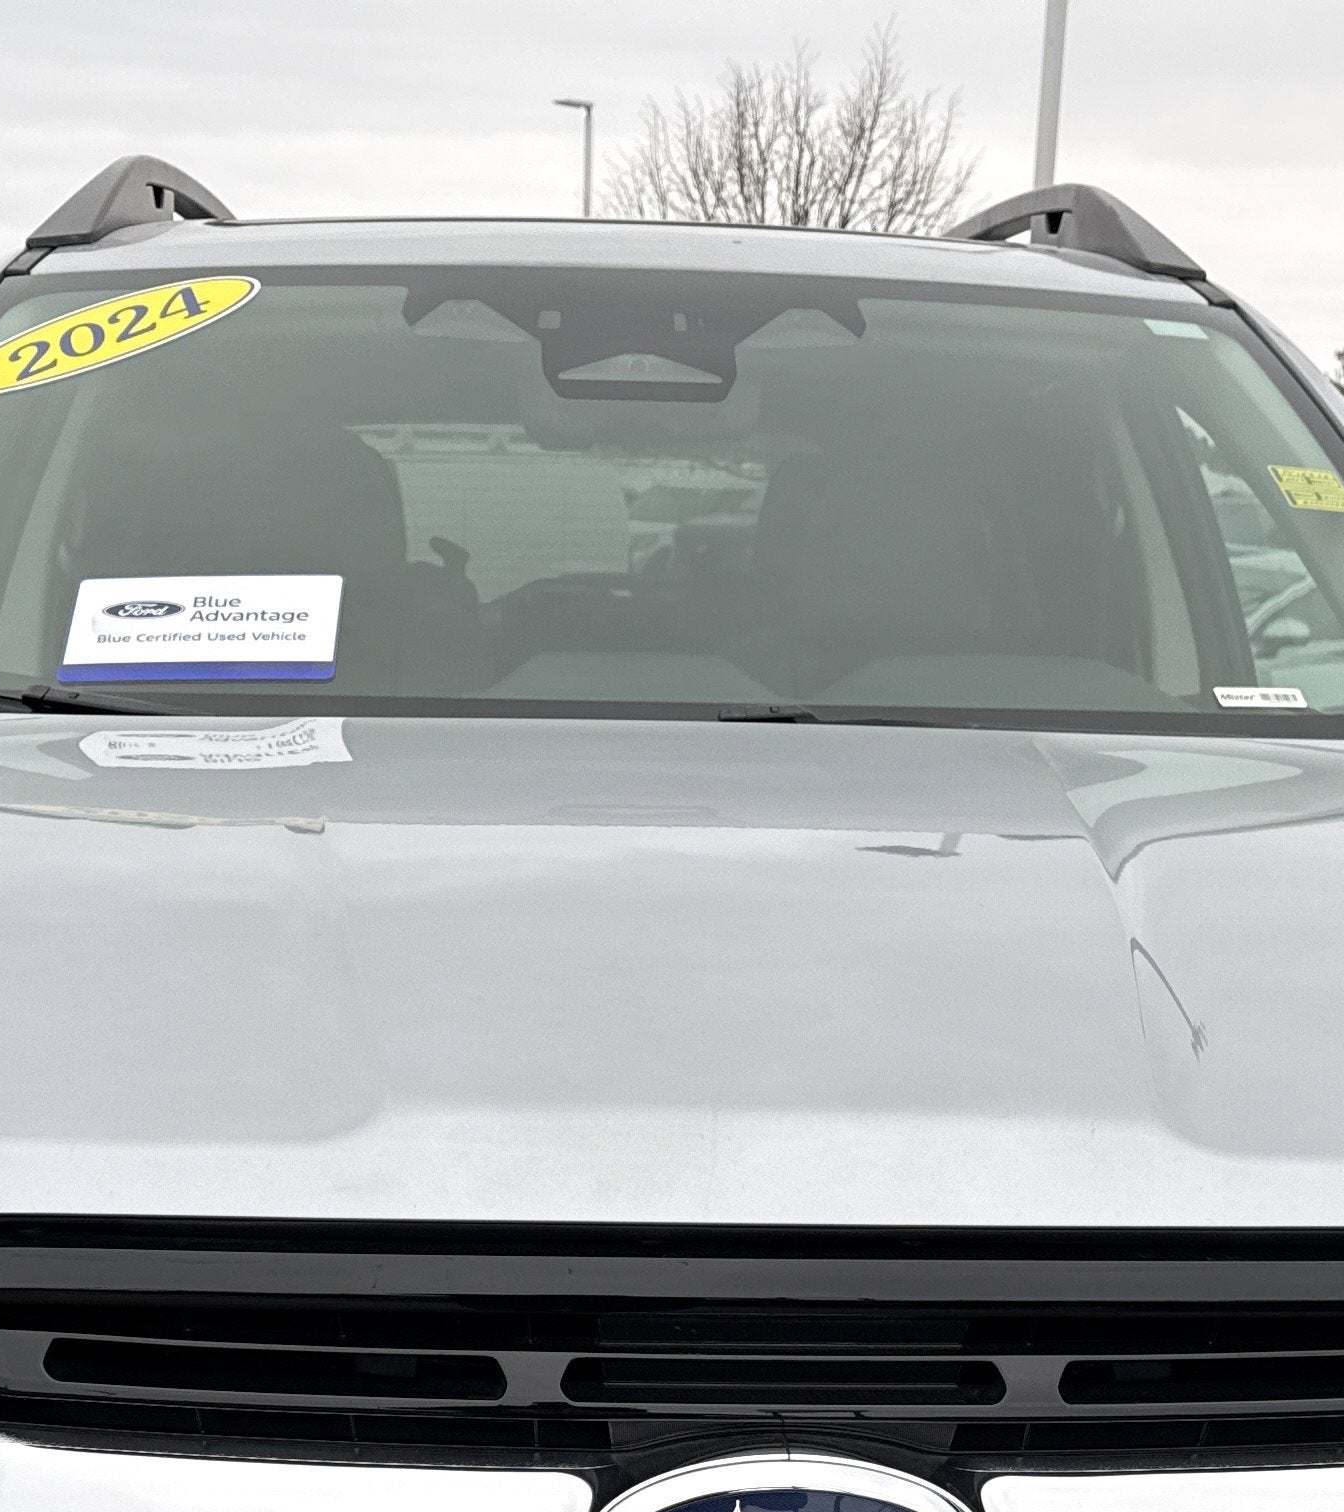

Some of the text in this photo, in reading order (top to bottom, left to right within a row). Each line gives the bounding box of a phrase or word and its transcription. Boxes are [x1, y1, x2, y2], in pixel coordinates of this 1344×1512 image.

[8, 286, 210, 382] 2024
[193, 596, 242, 608] Blue
[118, 602, 170, 617] Ford
[189, 610, 309, 624] Advantage
[97, 632, 306, 643] Blue Certified Used Vehicle
